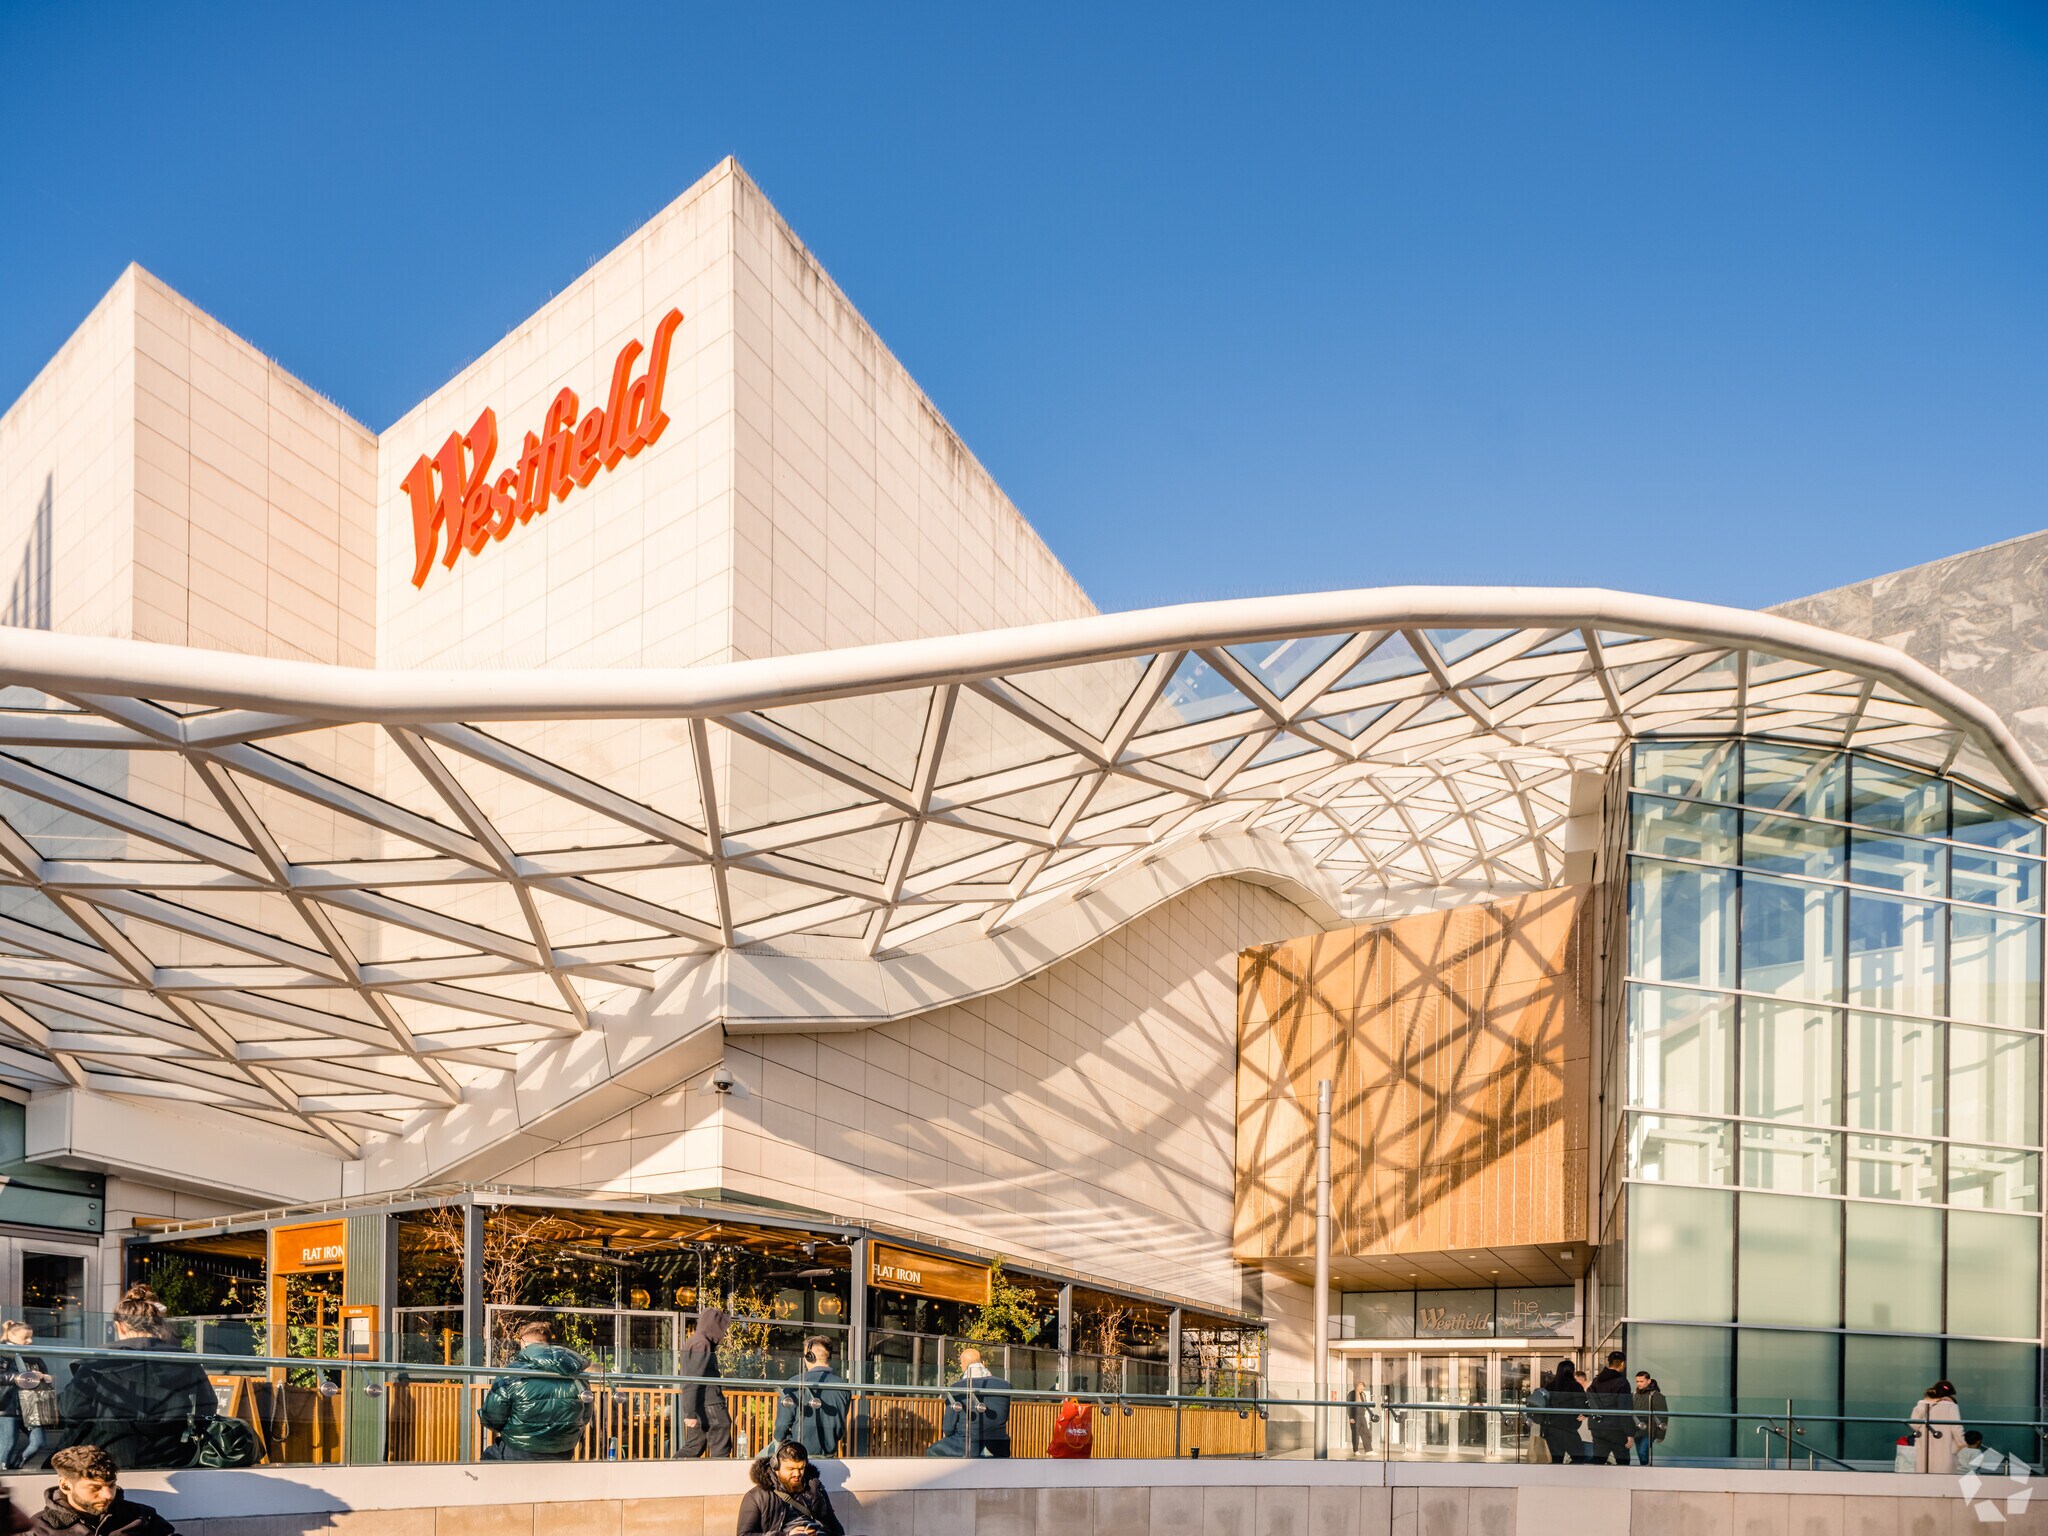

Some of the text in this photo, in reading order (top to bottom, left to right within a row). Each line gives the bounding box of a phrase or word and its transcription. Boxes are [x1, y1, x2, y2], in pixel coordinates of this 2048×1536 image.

[399, 306, 685, 591] Westfield
[303, 1245, 344, 1261] FLAT IRON
[874, 1263, 921, 1284] FLAT IRON
[1513, 1299, 1539, 1313] the
[1419, 1307, 1492, 1331] Westfield
[1500, 1311, 1576, 1330] VILLAGE
